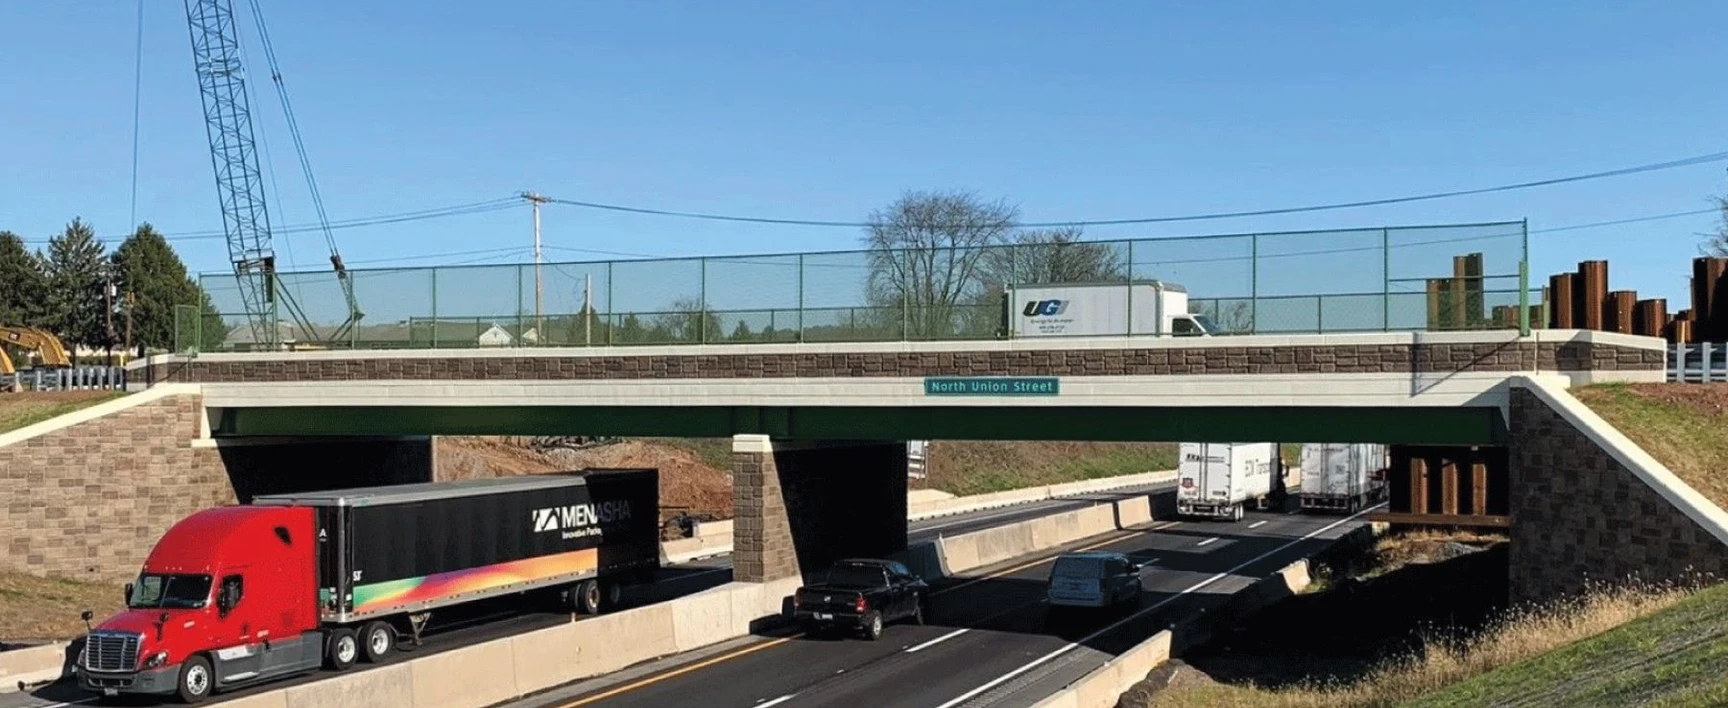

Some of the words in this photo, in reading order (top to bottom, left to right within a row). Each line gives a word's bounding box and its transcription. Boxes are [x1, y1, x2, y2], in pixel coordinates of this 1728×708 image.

[1023, 299, 1070, 317] UGI
[932, 381, 966, 393] North
[971, 381, 1008, 392] Union
[1013, 381, 1053, 392] Street
[561, 499, 631, 529] MENASHA
